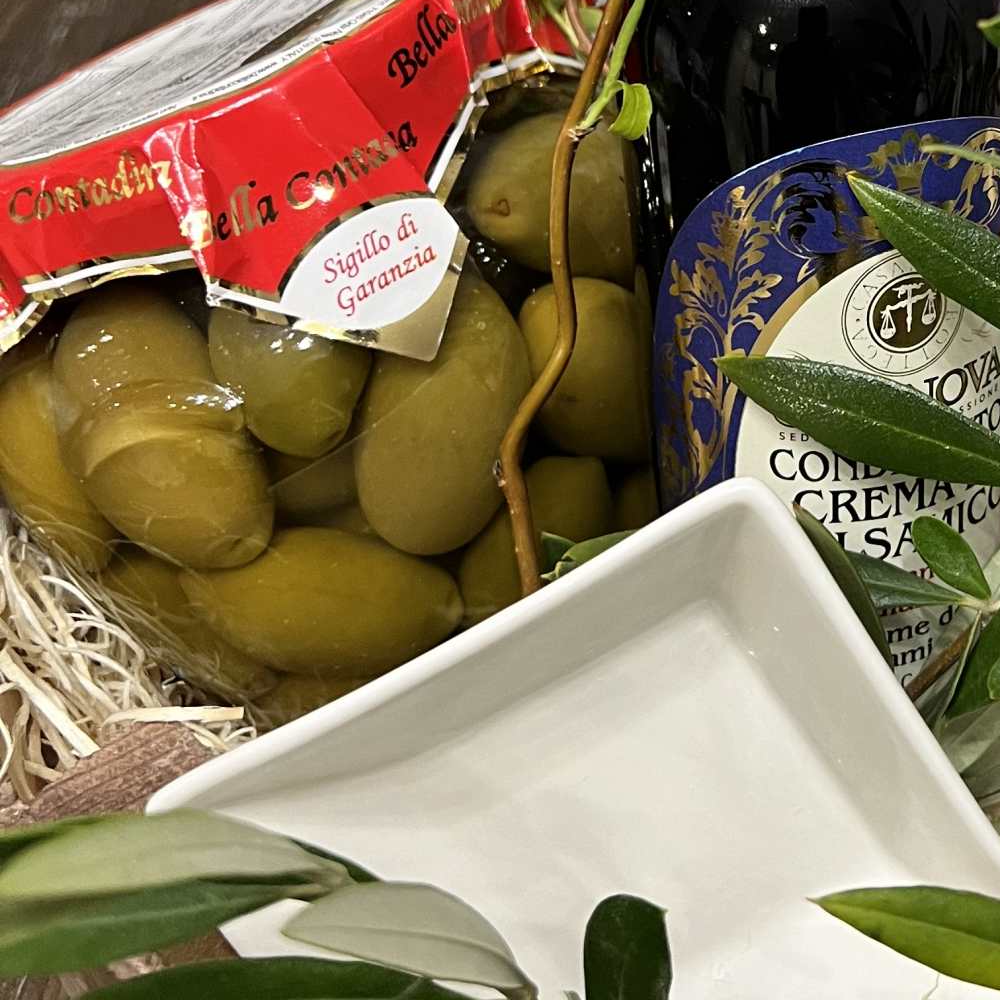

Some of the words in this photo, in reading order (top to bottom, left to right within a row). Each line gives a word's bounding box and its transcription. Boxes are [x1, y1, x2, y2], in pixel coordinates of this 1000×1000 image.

[387, 3, 457, 88] Bella
[323, 223, 391, 284] Sigillo
[397, 212, 418, 245] di
[336, 243, 438, 317] Garanzia
